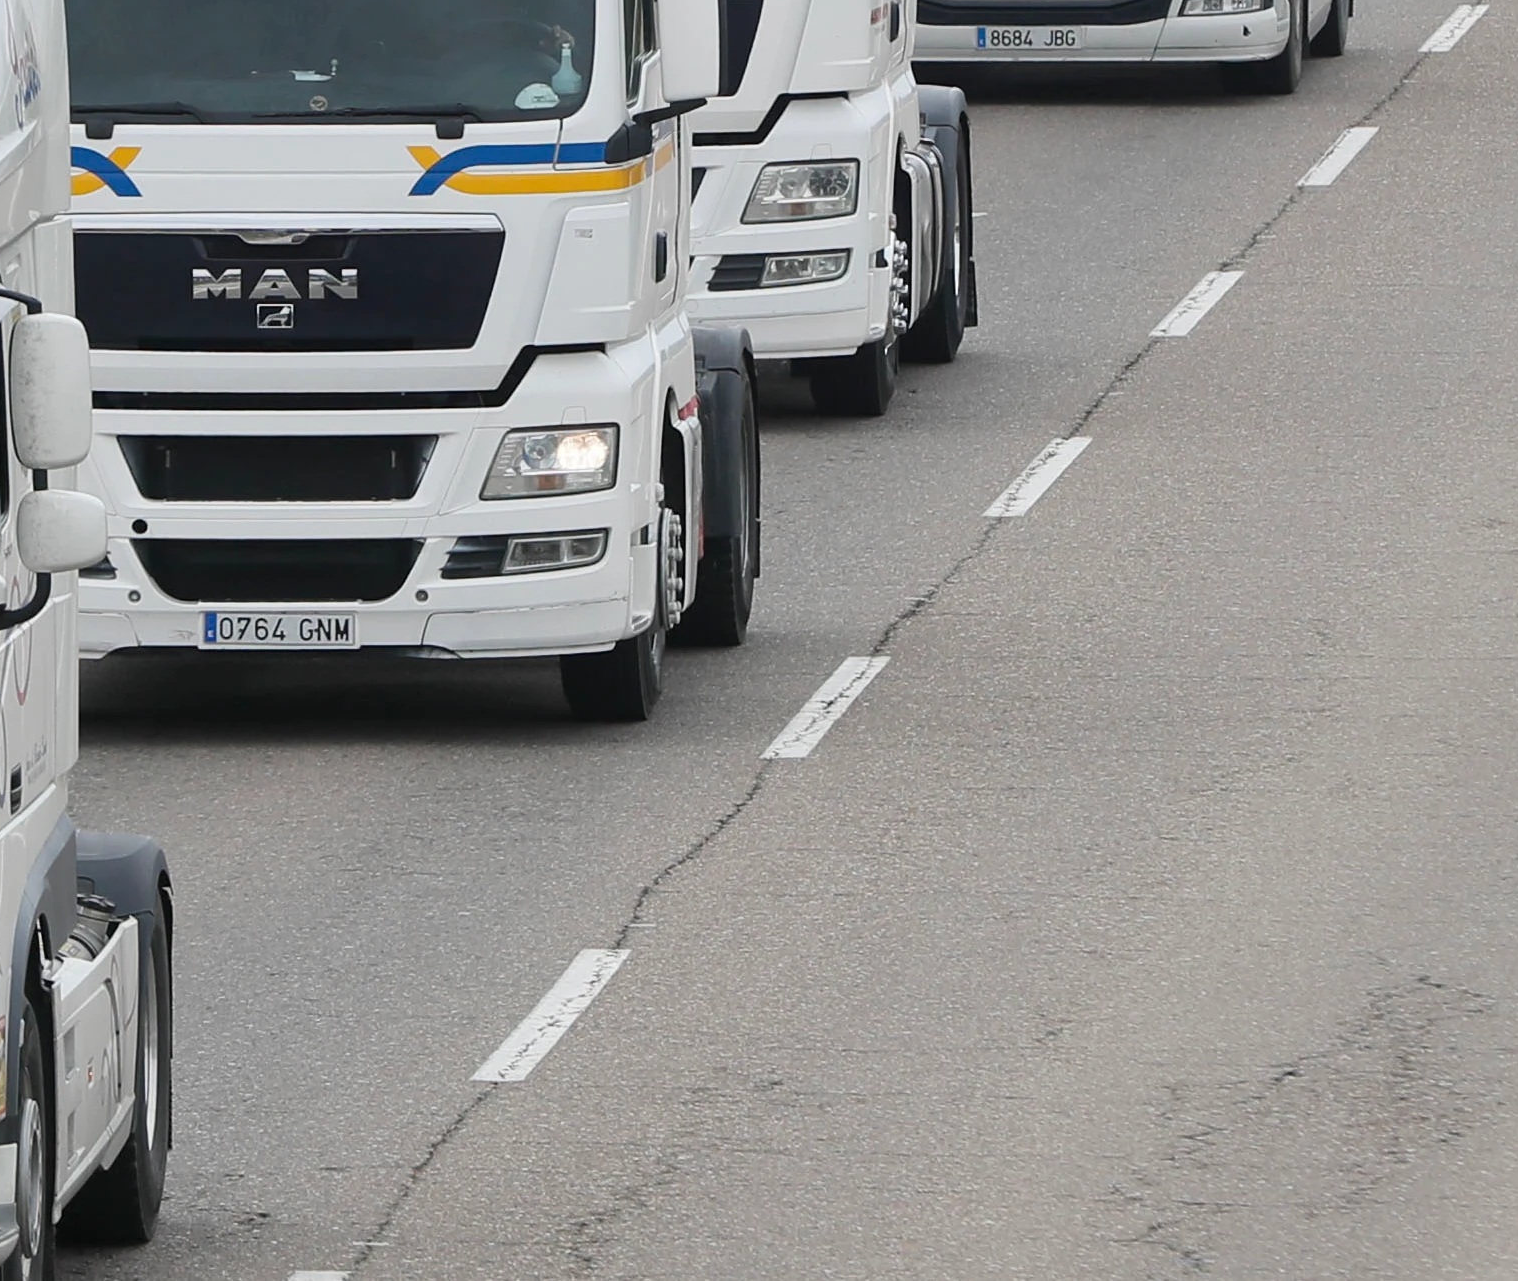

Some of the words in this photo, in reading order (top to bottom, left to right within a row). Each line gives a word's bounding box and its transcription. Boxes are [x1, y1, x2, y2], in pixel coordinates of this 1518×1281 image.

[990, 29, 1033, 46] 8684
[1043, 29, 1076, 46] JBG
[190, 267, 358, 300] MAN
[219, 617, 286, 641] 0764
[299, 618, 350, 642] GNM
